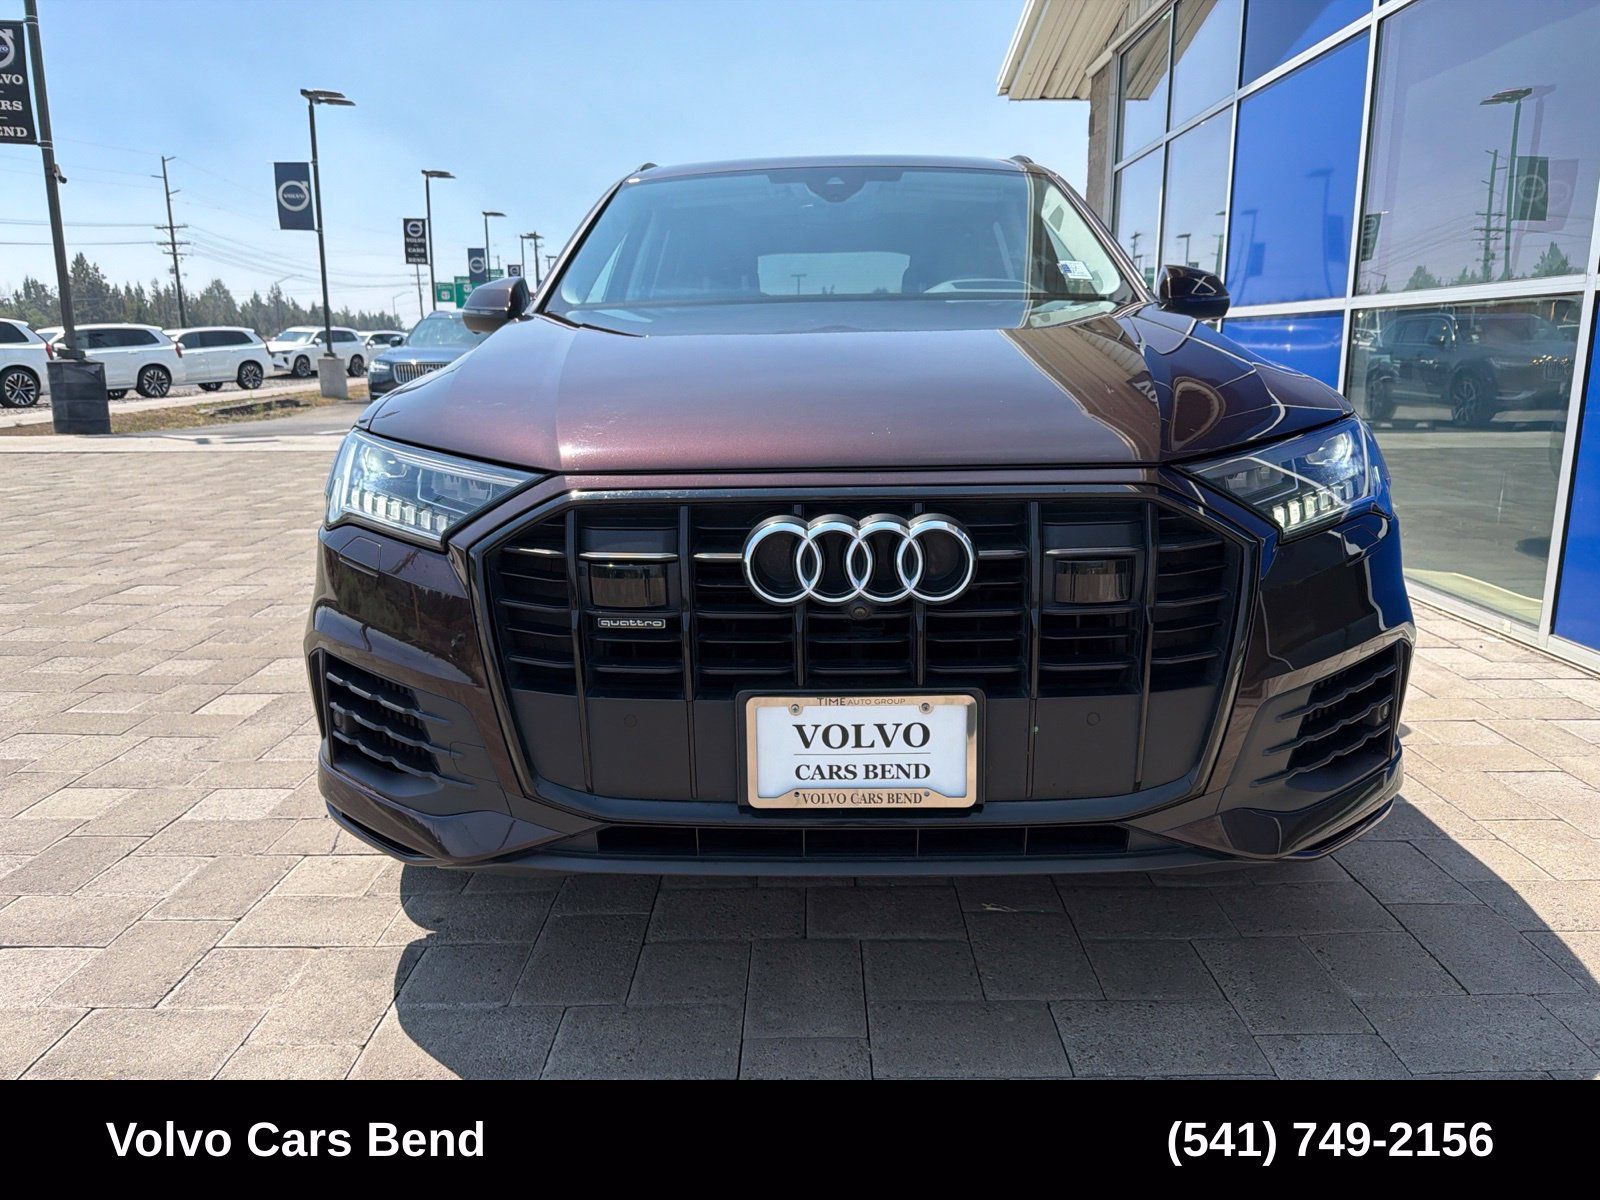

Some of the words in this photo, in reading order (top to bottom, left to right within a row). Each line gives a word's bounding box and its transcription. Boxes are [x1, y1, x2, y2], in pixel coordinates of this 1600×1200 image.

[600, 619, 663, 627] quattro
[817, 697, 846, 706] TIME
[792, 722, 931, 750] VOLVO
[795, 763, 858, 781] CARS
[863, 763, 931, 780] BEND
[802, 792, 847, 804] VOLVO
[850, 792, 884, 804] CARS
[887, 792, 923, 804] BEND
